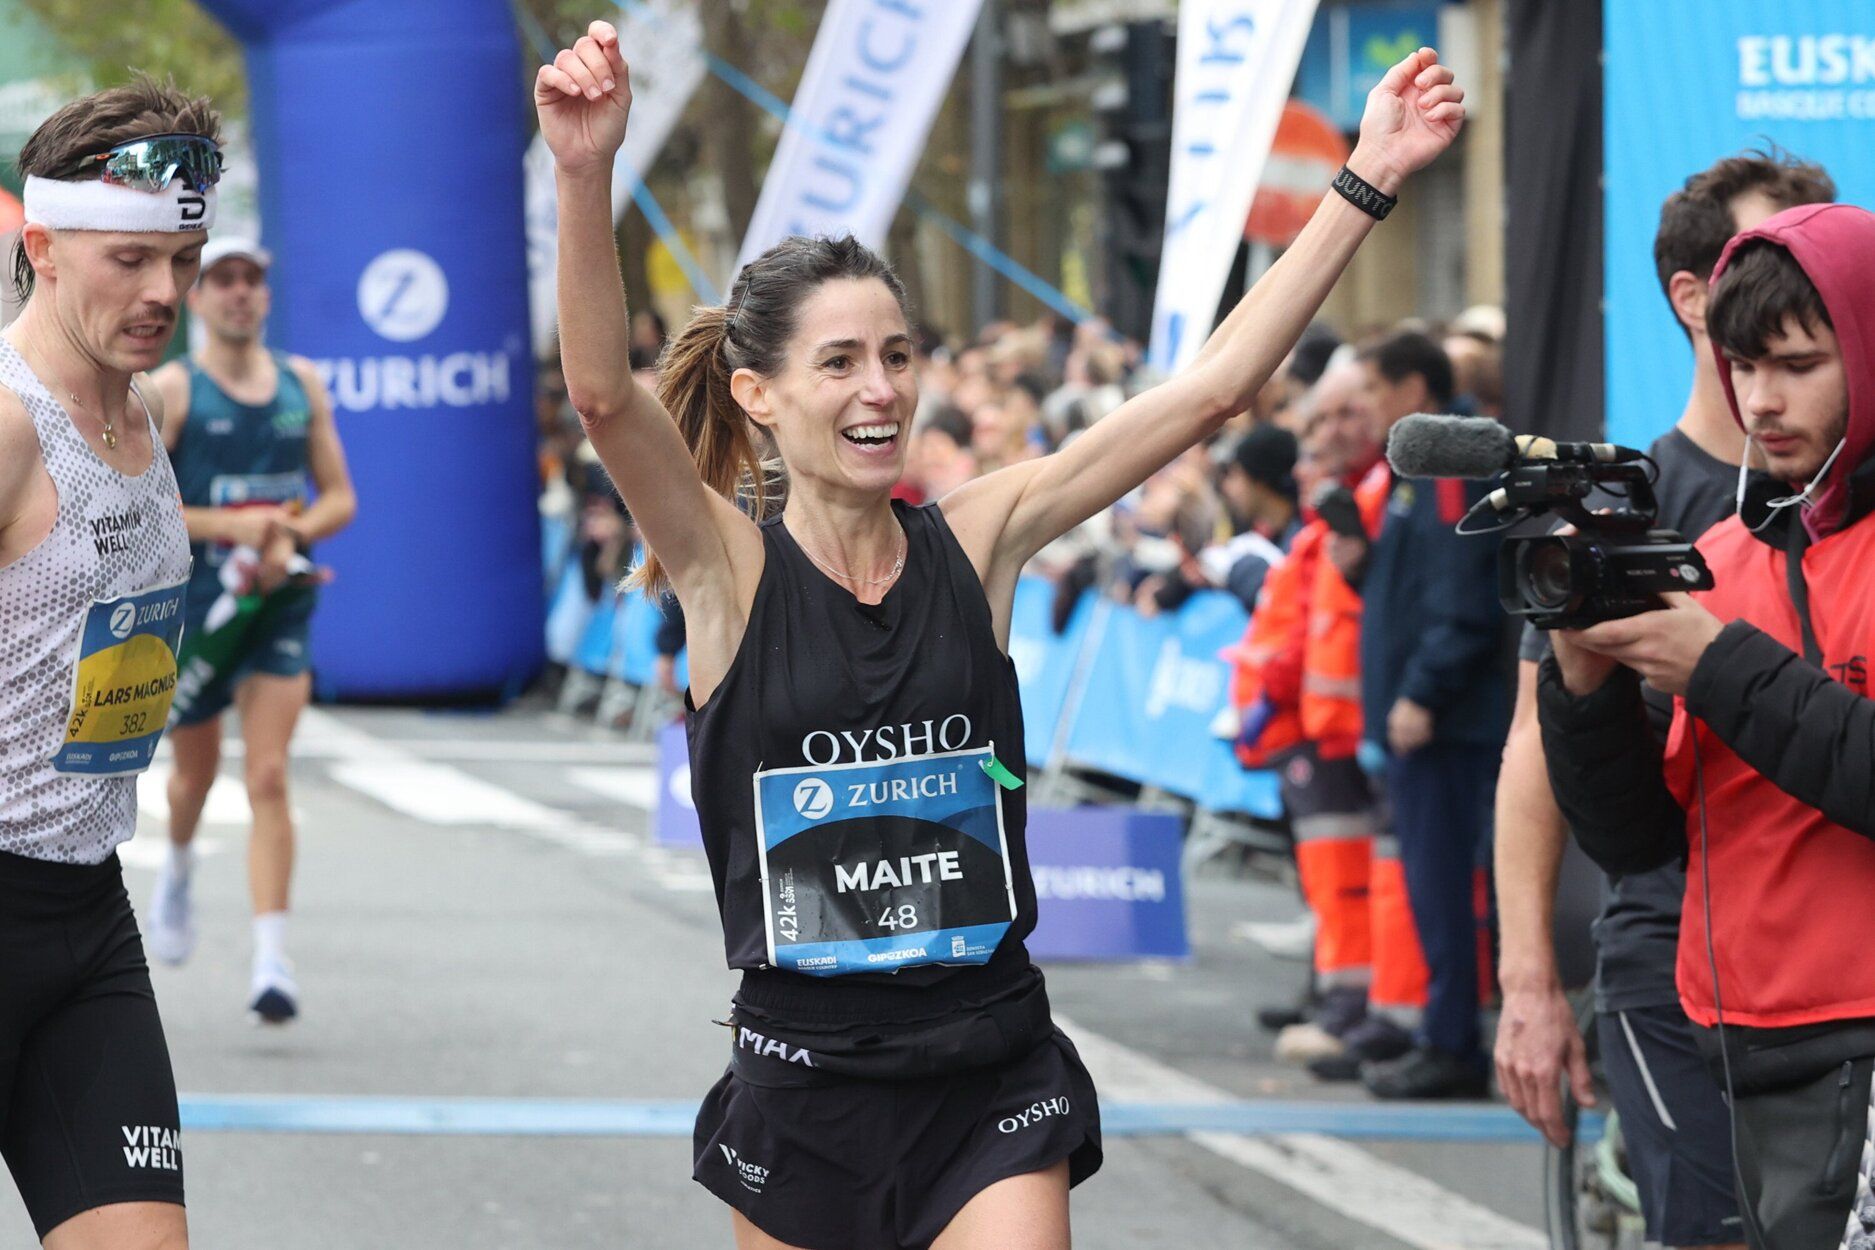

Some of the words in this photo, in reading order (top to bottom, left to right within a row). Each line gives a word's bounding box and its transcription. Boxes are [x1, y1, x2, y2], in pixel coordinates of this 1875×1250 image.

[91, 511, 142, 537] VITAMIN
[94, 533, 129, 556] WELL
[136, 597, 179, 626] ZURICH
[94, 686, 133, 707] LARS
[133, 672, 176, 700] MAGNUS
[69, 708, 88, 738] 42k
[119, 712, 147, 735] 382
[802, 713, 972, 767] OYSHO
[848, 772, 958, 808] ZURICH
[834, 850, 964, 893] MAITE
[777, 904, 798, 942] 42k
[877, 904, 918, 931] 48
[796, 956, 837, 967] EUSKADI
[998, 1096, 1070, 1134] OYSHO
[122, 1146, 178, 1171] WELL
[737, 1158, 770, 1178] VICKY
